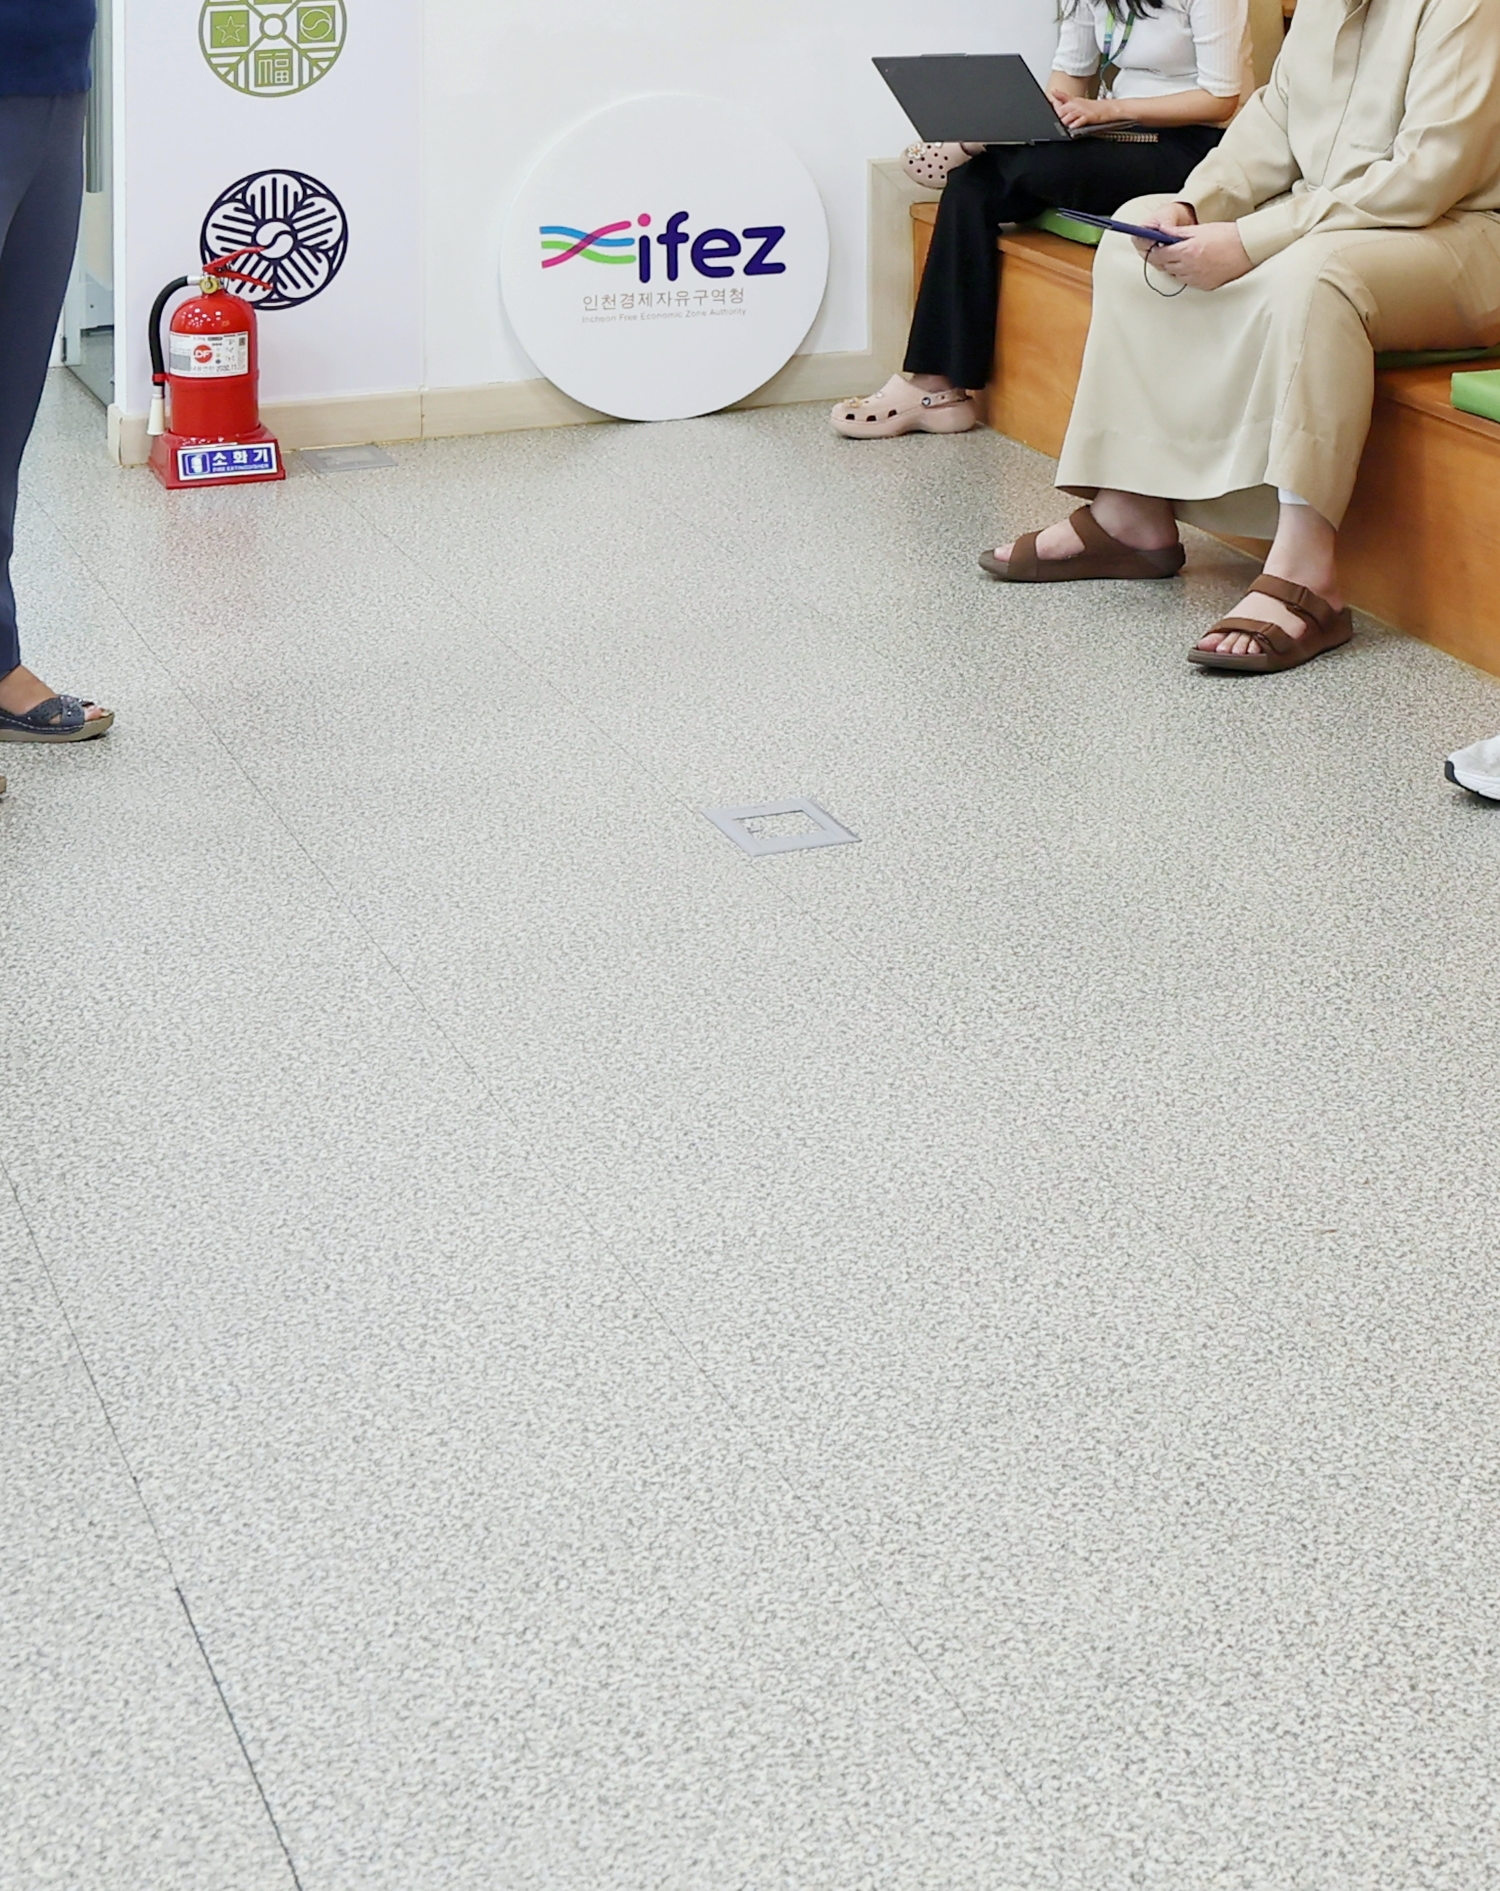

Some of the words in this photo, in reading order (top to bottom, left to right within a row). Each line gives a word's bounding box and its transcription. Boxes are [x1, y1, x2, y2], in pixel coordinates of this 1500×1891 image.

[638, 211, 786, 283] ifez
[582, 288, 745, 312] 인천경제자유구역청
[582, 314, 616, 324] Incheon
[619, 312, 638, 321] Free
[640, 310, 682, 320] Economic
[685, 309, 707, 318] Zone
[710, 307, 746, 317] Authority
[212, 448, 269, 466] 소화기
